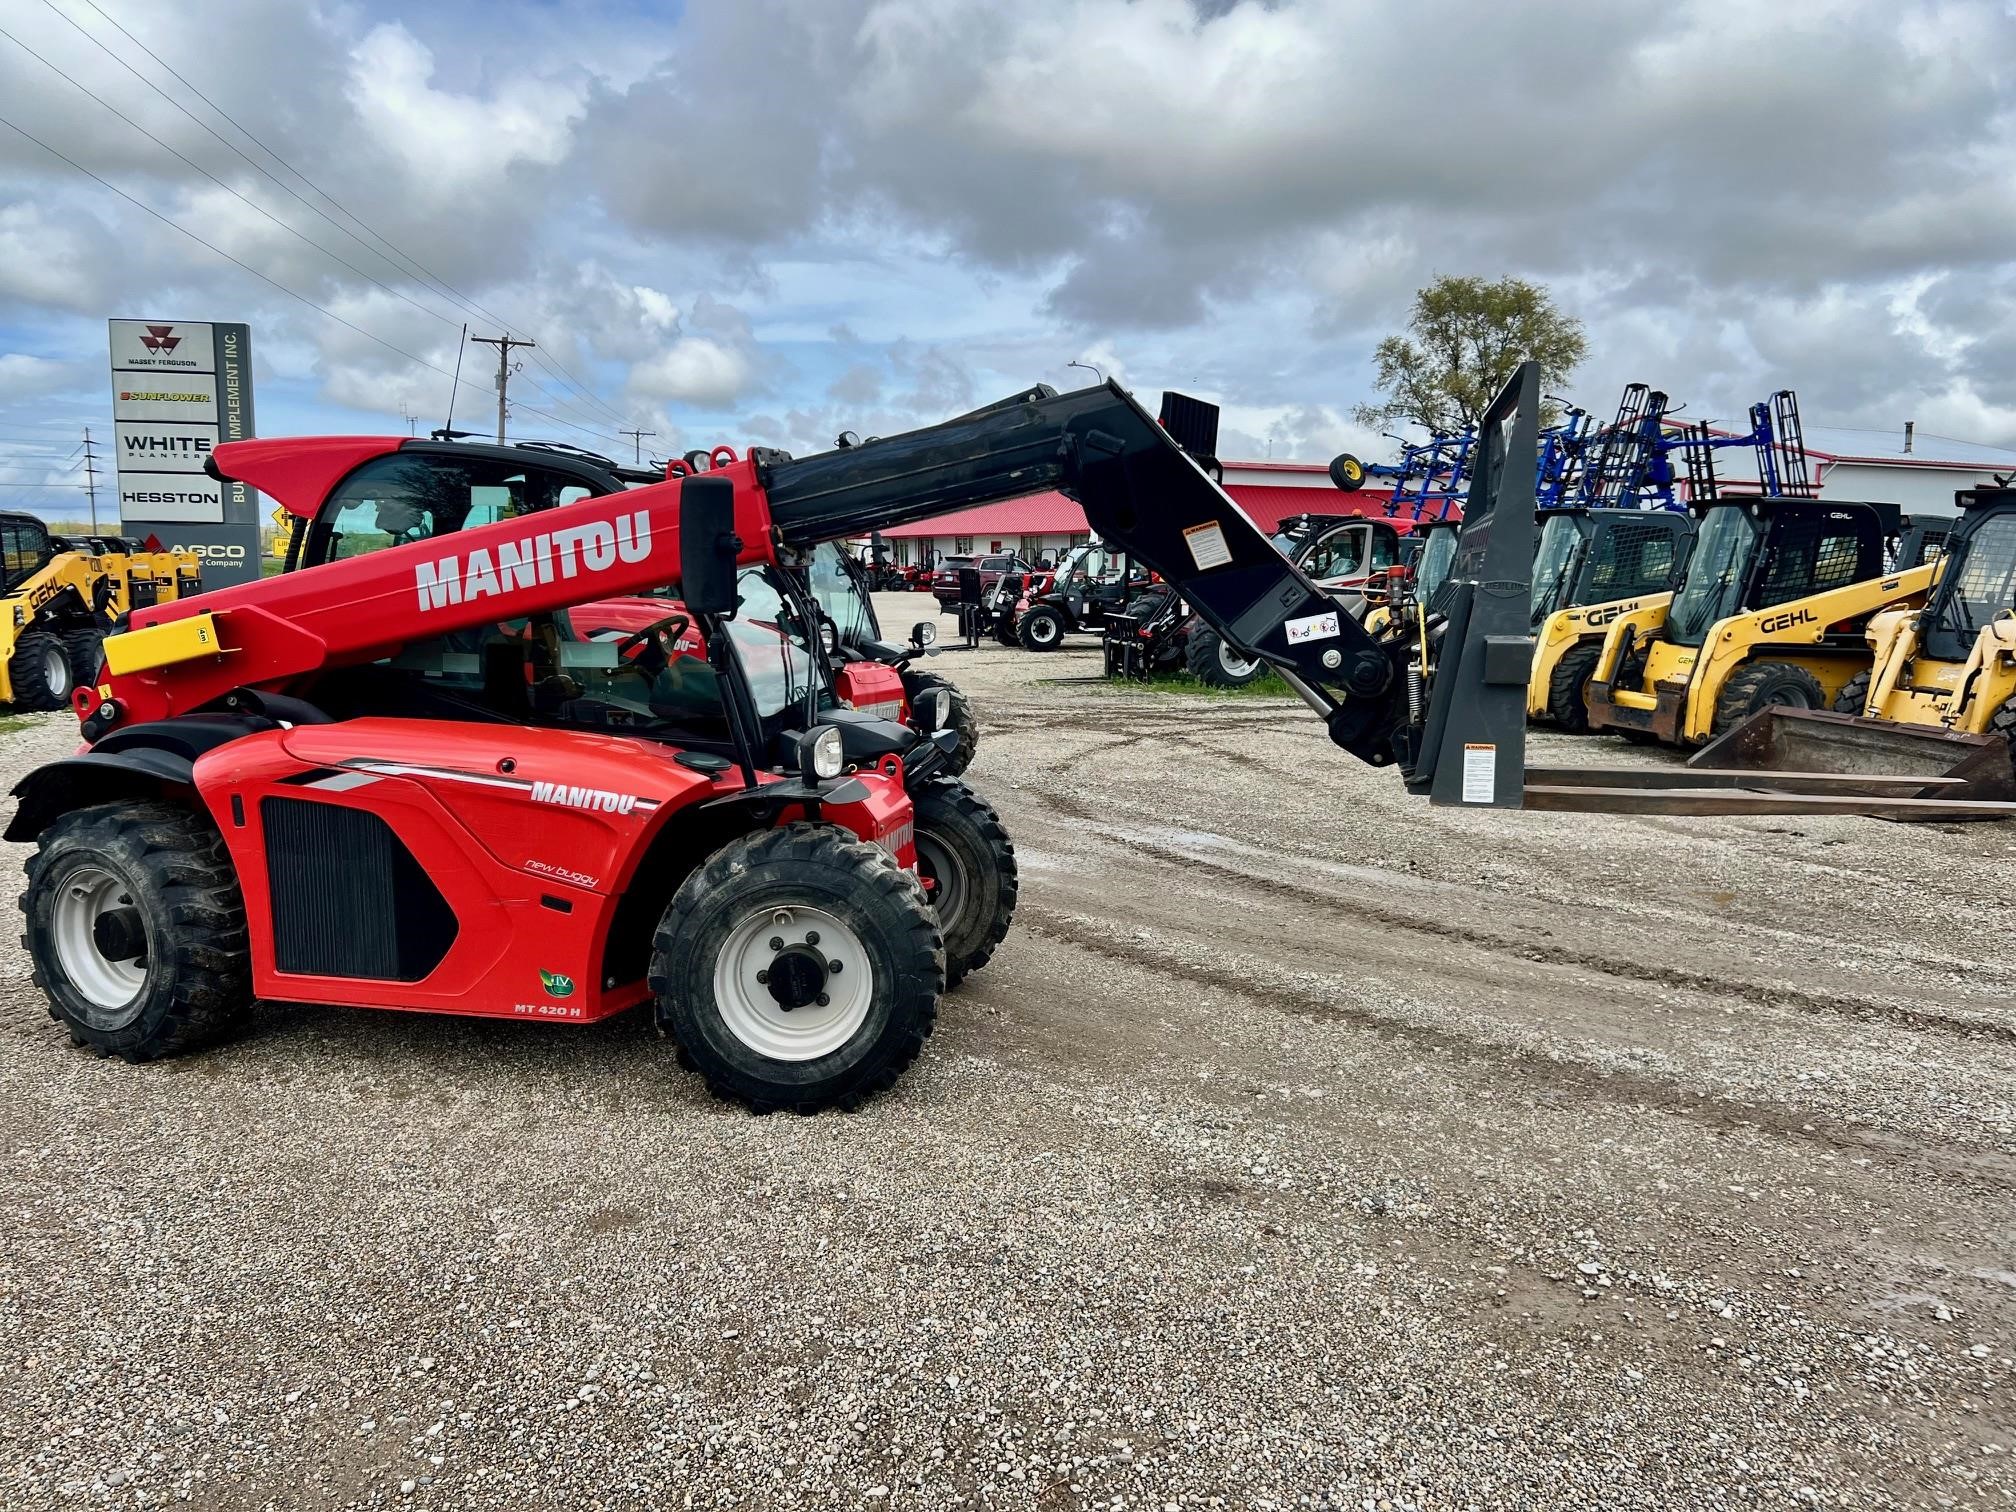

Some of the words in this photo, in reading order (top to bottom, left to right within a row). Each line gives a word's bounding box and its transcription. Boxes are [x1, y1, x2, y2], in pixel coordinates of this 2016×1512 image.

[224, 332, 237, 358] INC.
[128, 358, 156, 366] MASSEY
[158, 359, 197, 367] FERGUSON
[226, 361, 242, 439] IMPLEMENT
[124, 436, 211, 452] WHITE
[122, 492, 219, 504] HESSTON
[1830, 512, 1853, 520] GEHL
[205, 559, 244, 568] Company
[414, 509, 653, 612] MANITOU
[29, 576, 64, 610] GEHL
[1760, 608, 1818, 634] GEHL
[530, 781, 636, 815] MANITOU
[525, 859, 555, 872] new
[556, 867, 600, 886] buggy
[514, 1004, 536, 1014] MT
[538, 1006, 567, 1015] 420
[570, 1008, 581, 1017] H
